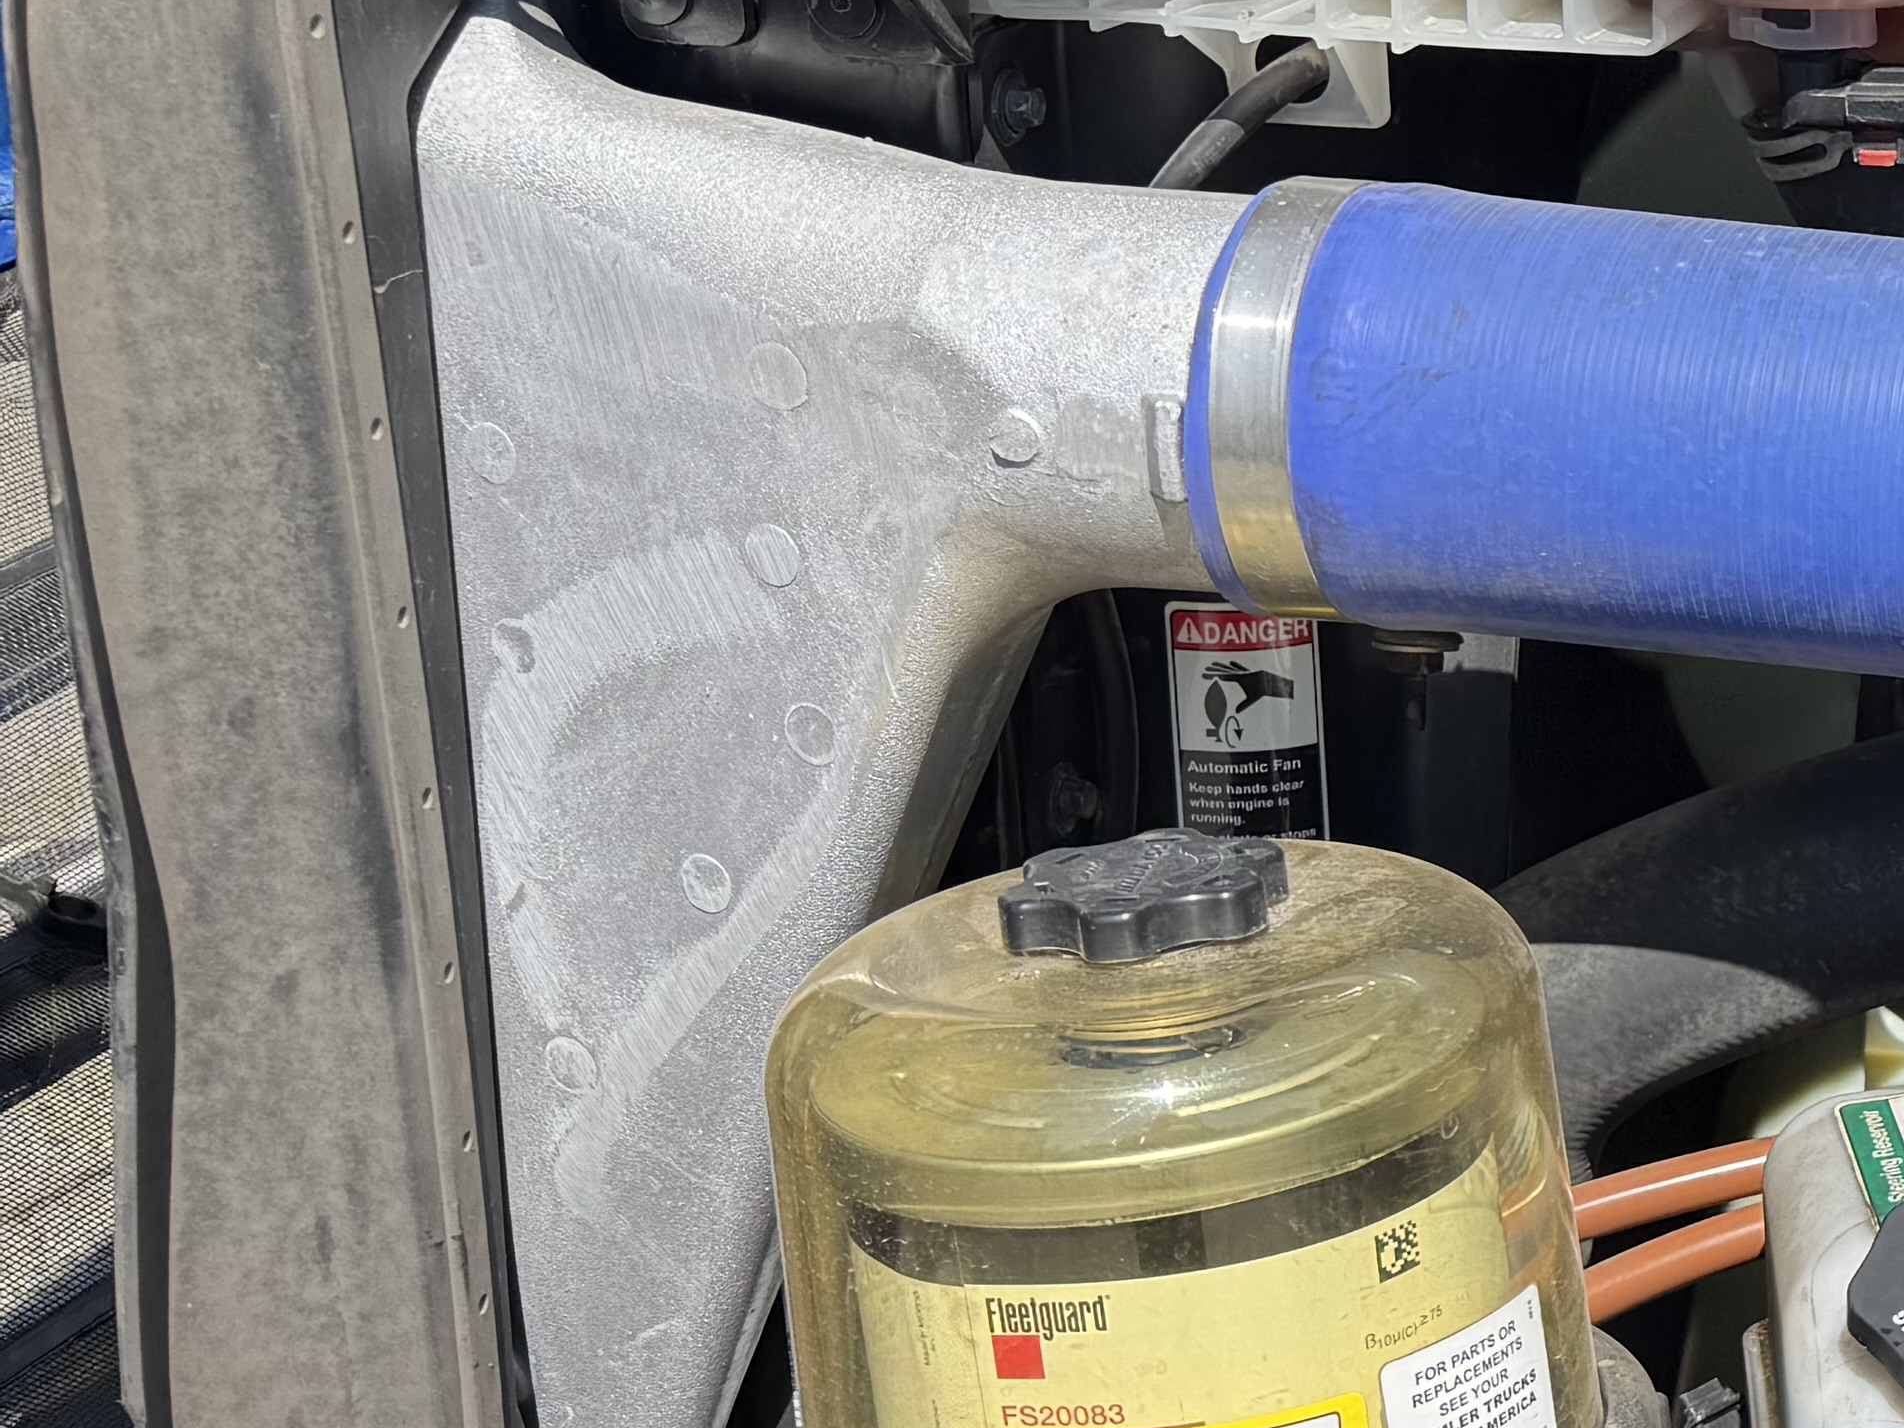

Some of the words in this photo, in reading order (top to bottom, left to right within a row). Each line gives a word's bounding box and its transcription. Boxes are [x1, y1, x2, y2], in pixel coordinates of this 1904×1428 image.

[1203, 619, 1309, 644] DANGER
[1188, 759, 1268, 774] Automatic
[1273, 757, 1301, 772] Fan
[1189, 781, 1222, 795] Keep
[1226, 781, 1268, 795] hands
[1272, 779, 1304, 793] clear
[1190, 797, 1224, 809] when
[1228, 797, 1274, 812] engine
[1278, 796, 1290, 807] is
[1191, 812, 1246, 826] running.
[1862, 1110, 1896, 1158] Reservoir
[985, 1294, 1108, 1341] Fleetguard
[1415, 1362, 1447, 1385] FOR
[1451, 1334, 1495, 1369] PARTS
[1499, 1320, 1517, 1340] OR
[1411, 1336, 1523, 1409] REPLACEMENTS
[1439, 1394, 1468, 1417] SEE
[1471, 1368, 1509, 1402] YOUR
[1483, 1368, 1537, 1413] TRUCKS
[1001, 1404, 1125, 1427] FS20083
